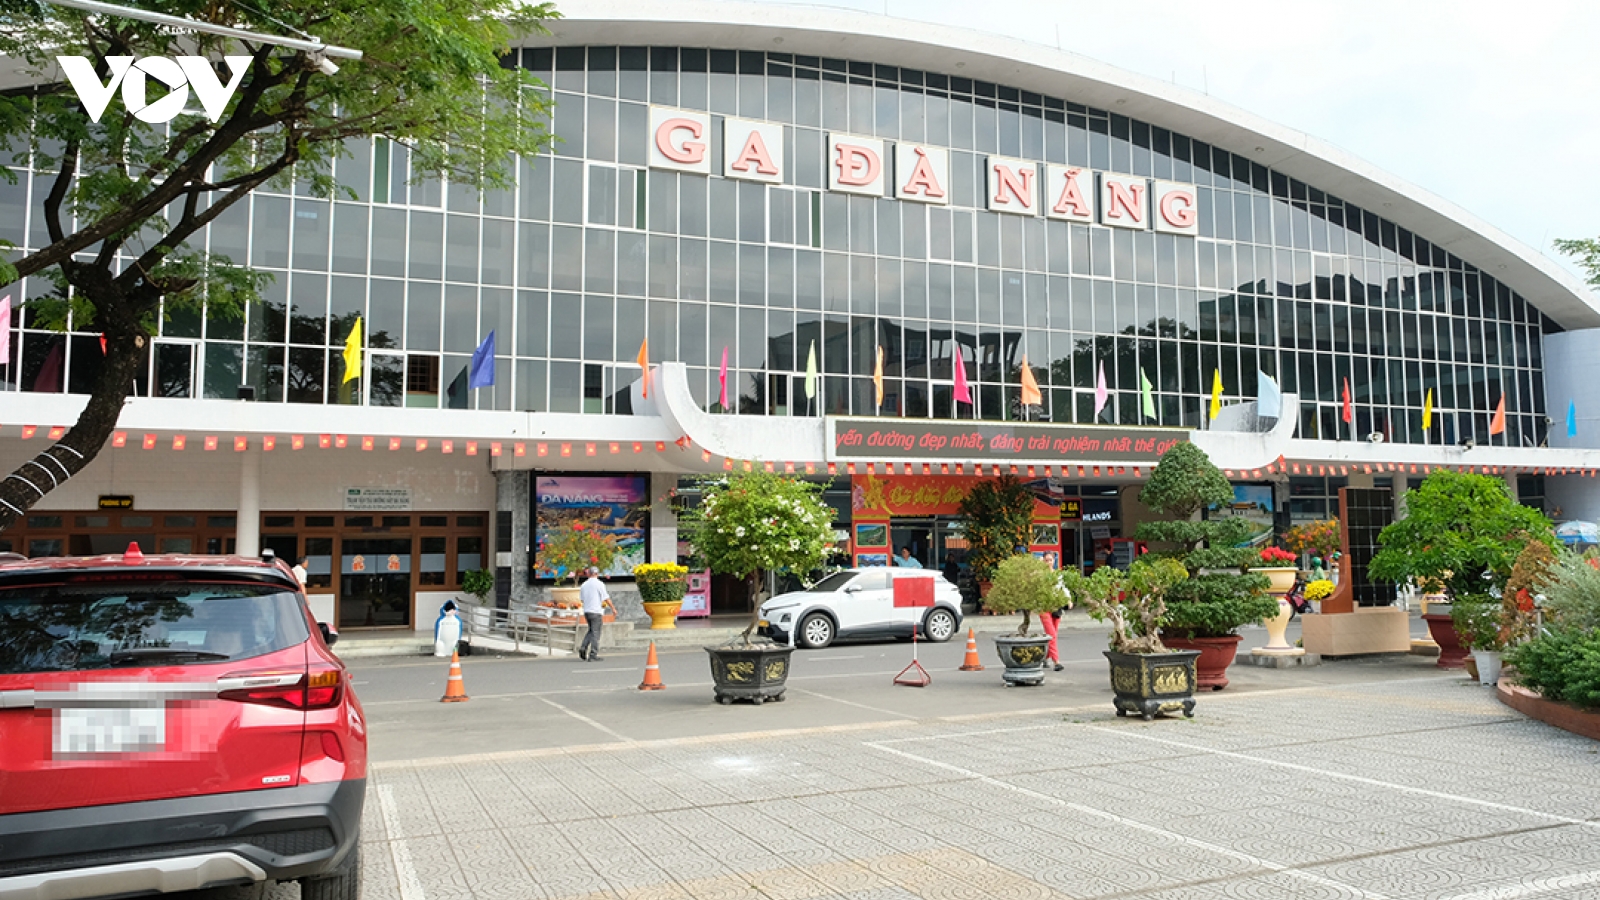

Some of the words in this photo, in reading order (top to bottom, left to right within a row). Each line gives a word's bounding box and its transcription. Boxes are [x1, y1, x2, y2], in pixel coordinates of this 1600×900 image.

[655, 118, 779, 175] GA
[835, 143, 944, 197] ĐÀ
[866, 430, 916, 451] đường
[919, 431, 947, 451] đẹp
[950, 431, 985, 451] nhất,
[989, 433, 1025, 453] đáng
[1027, 434, 1051, 450] trải
[1053, 436, 1100, 454] nghiệm
[1103, 437, 1132, 453] nhất
